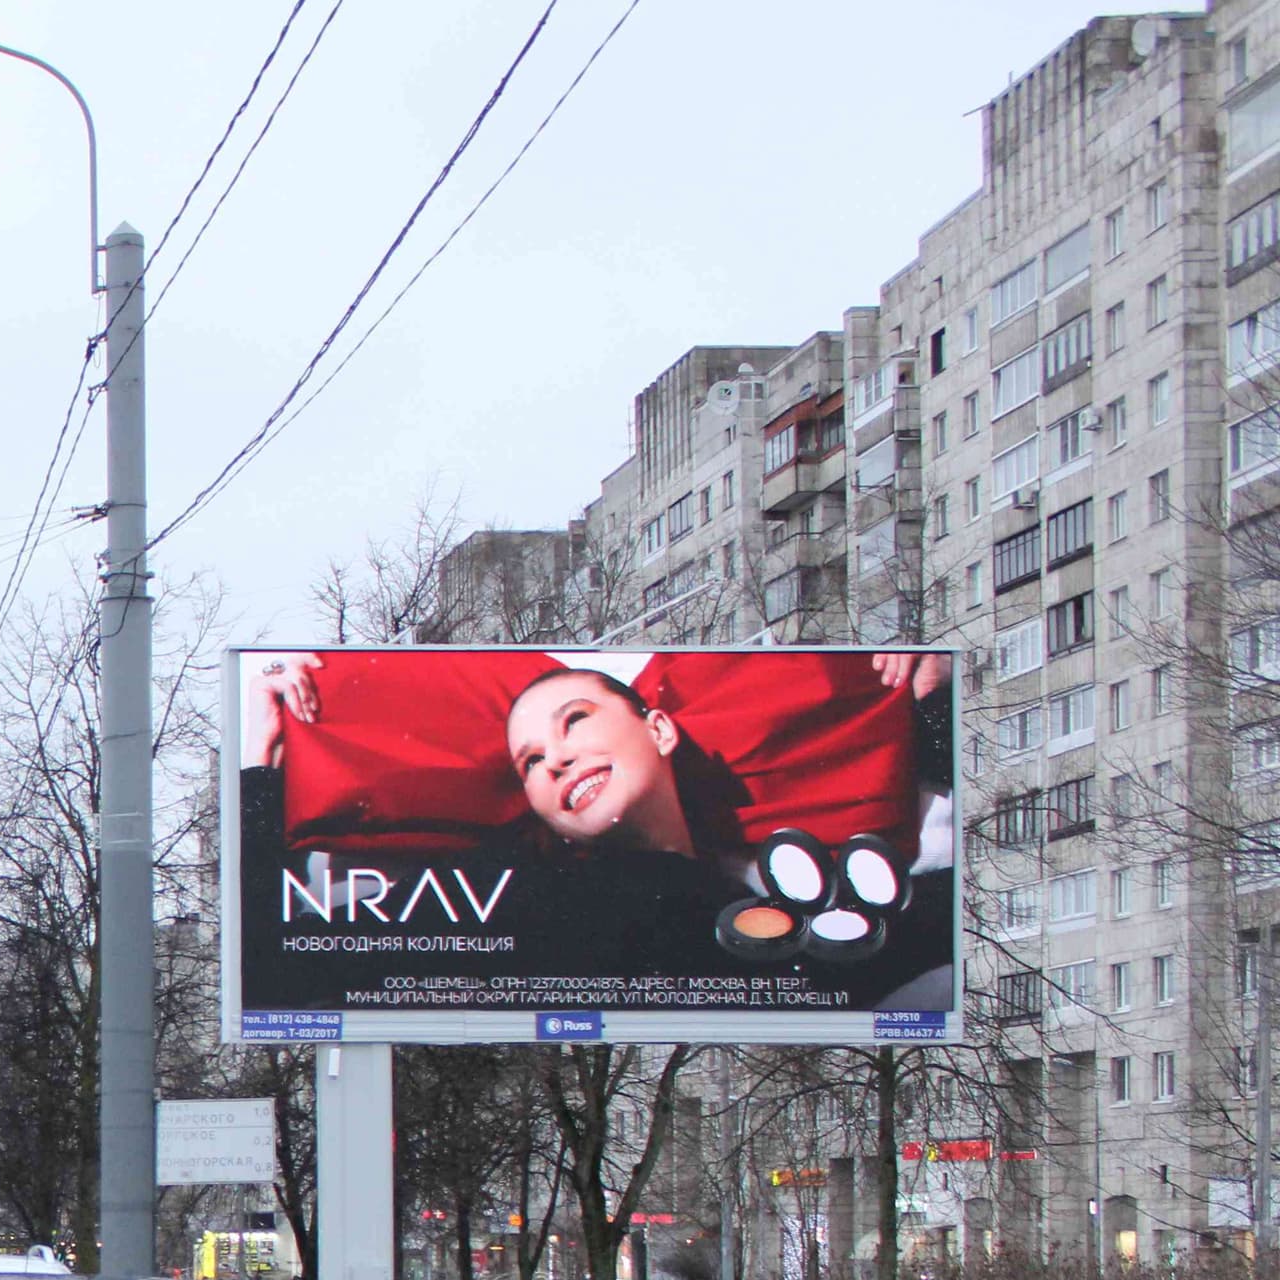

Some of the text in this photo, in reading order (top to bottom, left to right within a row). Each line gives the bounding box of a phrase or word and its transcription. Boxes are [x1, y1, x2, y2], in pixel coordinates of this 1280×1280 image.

[282, 868, 513, 923] NRAV
[283, 936, 515, 953] НОВОГОДНЯЯ КОЛЛЕКЦИЯ
[384, 976, 416, 989] ООО
[490, 976, 526, 989] ОГРН
[346, 989, 473, 1004] МУНИЦИПАЛЬНЫЙ
[476, 991, 518, 1004] ОКРУГ
[268, 1014, 293, 1025] (812)
[563, 1020, 593, 1031] Russ
[243, 1029, 286, 1039] договор:
